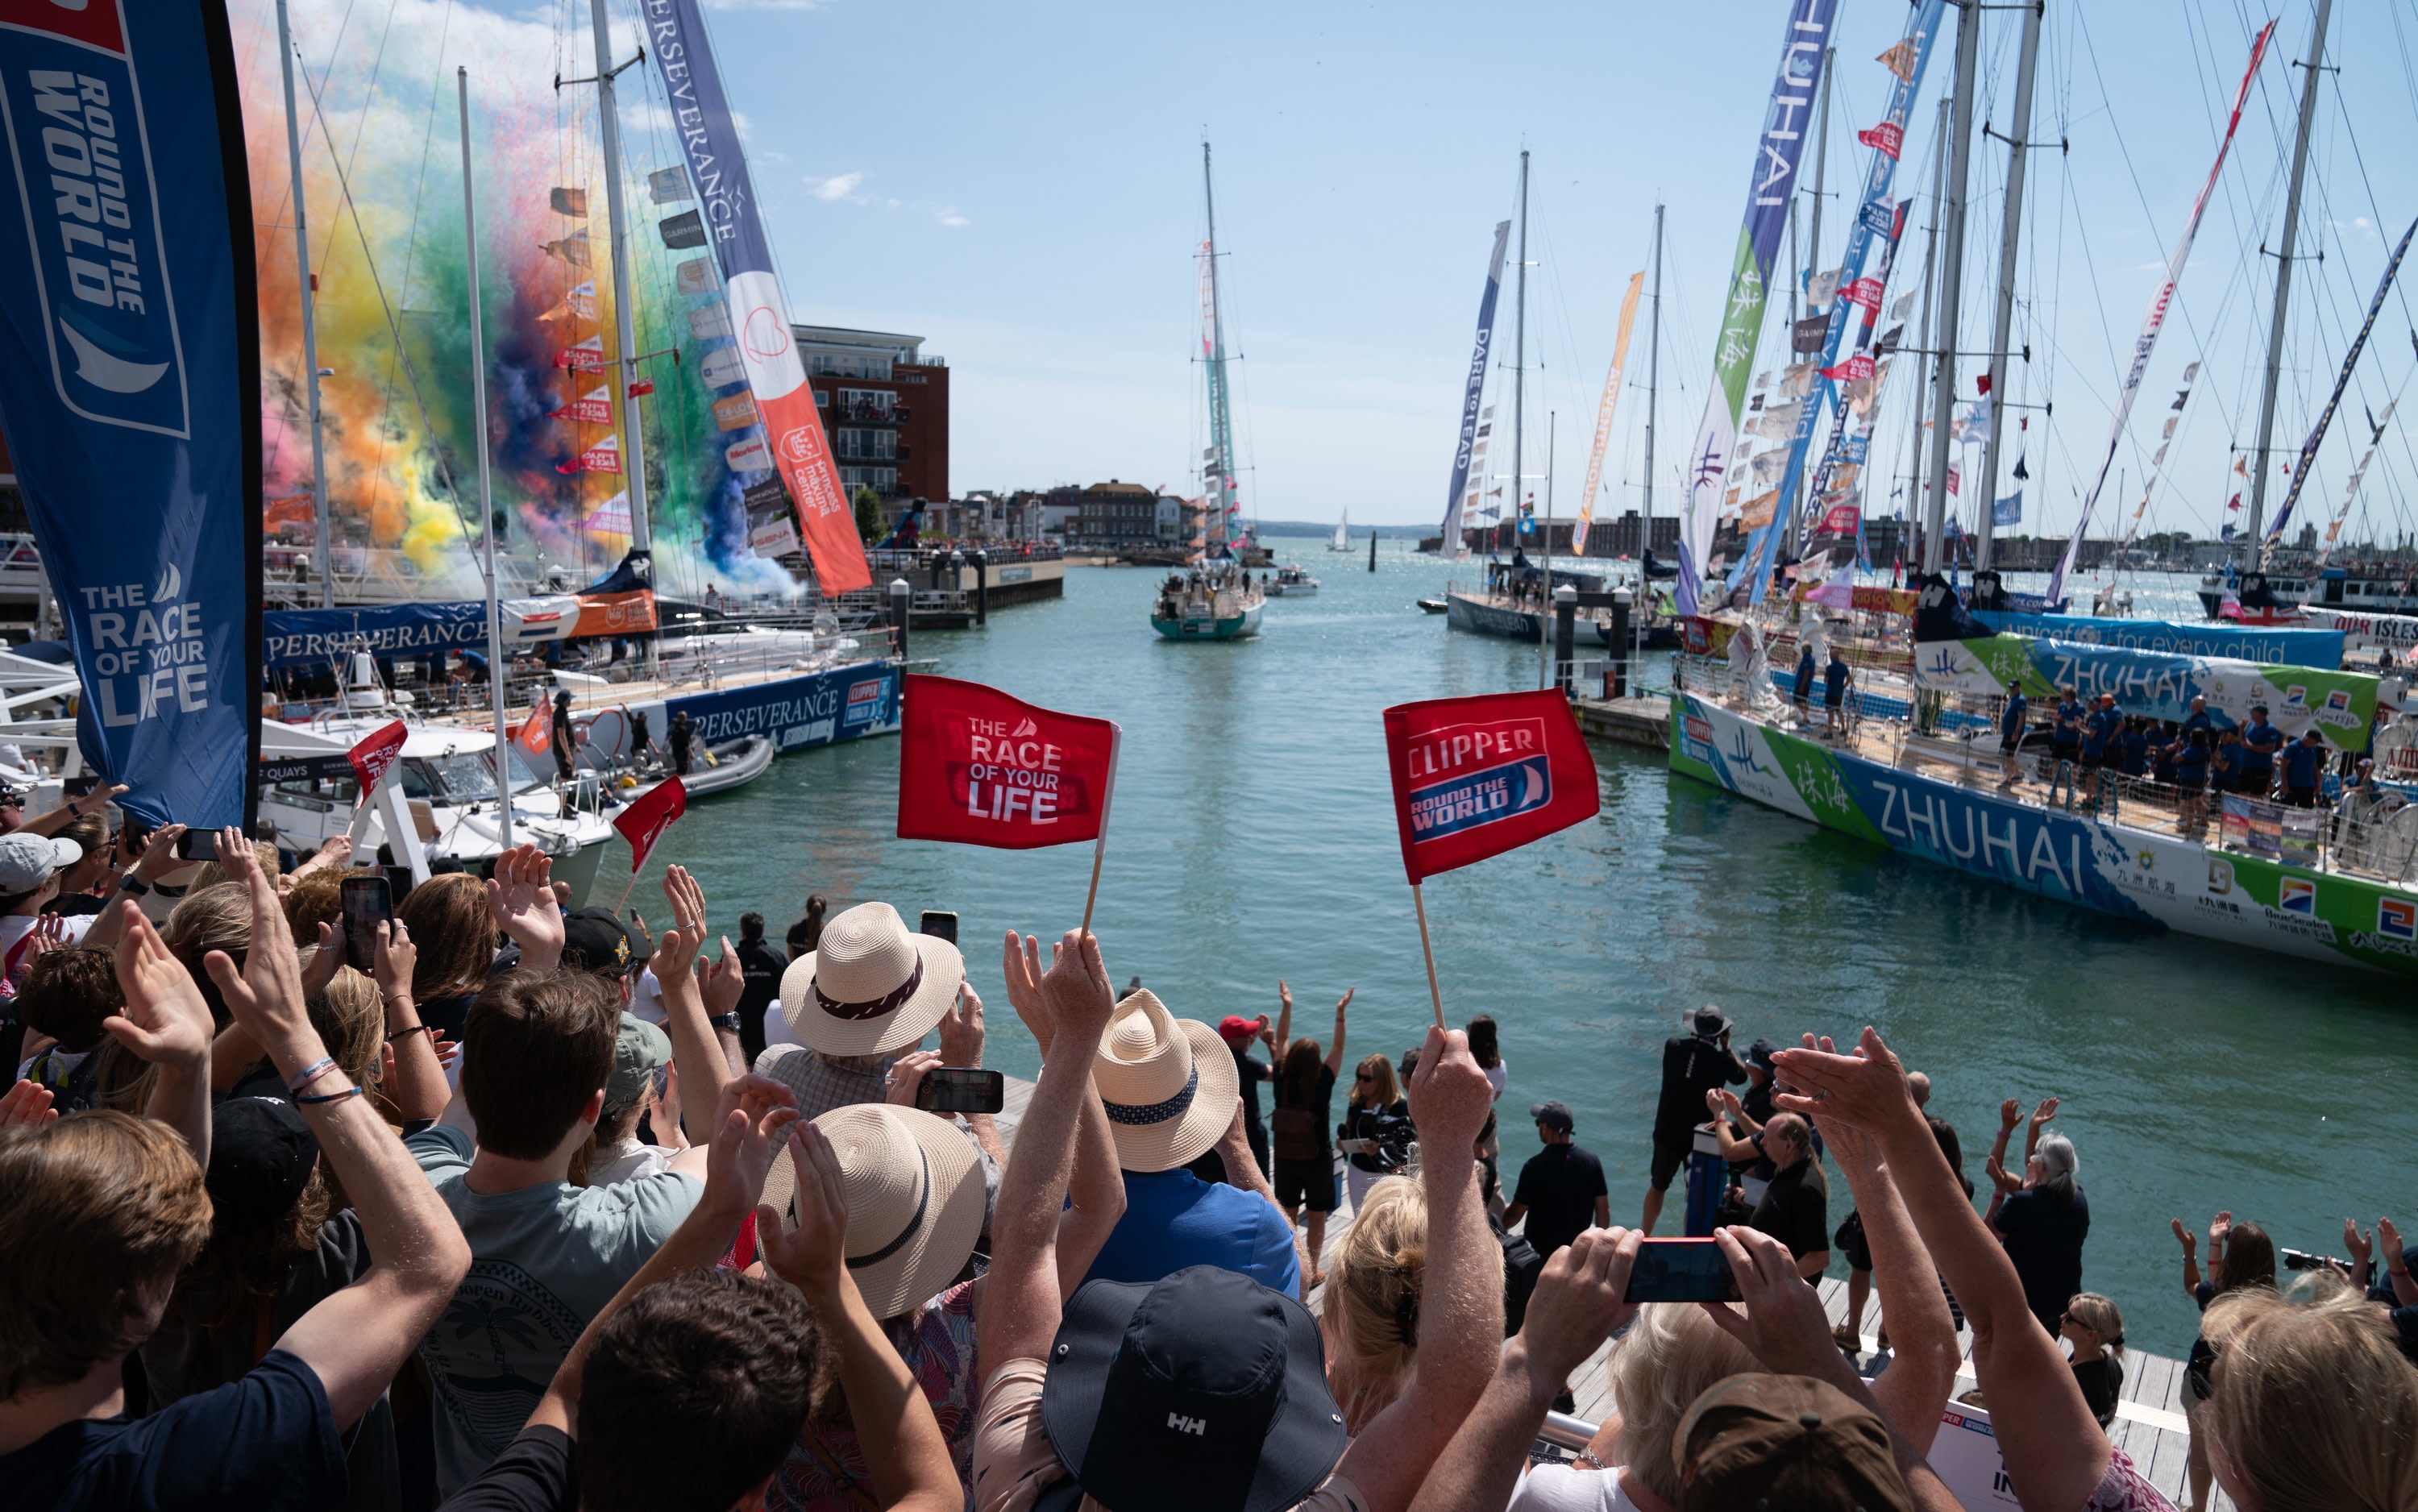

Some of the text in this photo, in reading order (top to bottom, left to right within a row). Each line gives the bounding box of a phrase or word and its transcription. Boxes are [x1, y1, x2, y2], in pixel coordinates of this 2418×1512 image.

[29, 69, 114, 307] WORLD
[77, 73, 145, 315] ROUND THE
[665, 224, 700, 239] GARMIN
[1456, 328, 1489, 470] DARE TO LEAD
[730, 443, 762, 460] Marlow
[795, 468, 816, 509] center
[815, 459, 841, 513] princess
[755, 530, 791, 547] SENA
[81, 584, 147, 609] THE
[89, 603, 202, 650] RACE
[265, 622, 489, 662] PERSEVERANCE
[95, 641, 206, 675] OF YOUR
[2151, 635, 2218, 658] every
[2225, 637, 2286, 665] child
[98, 663, 209, 727] LIFE
[850, 682, 879, 701] CLIPPER
[2053, 655, 2187, 704] ZHUHAI
[698, 688, 838, 738] PERSEVERANCE
[969, 717, 1007, 737] THE
[1688, 717, 1710, 741] CLIPPER
[323, 760, 351, 770] GUNWHA
[361, 752, 383, 790] LIFE
[970, 735, 1062, 771] RACE
[1408, 729, 1534, 779] CLIPPER
[268, 765, 308, 782] QUAYS
[970, 763, 1058, 791] OF YOUR
[968, 782, 1058, 825] LIFE
[1410, 777, 1507, 815] ROUND THE
[1412, 789, 1509, 832] WORLD
[1872, 779, 2084, 895] ZHUHAI
[1167, 1411, 1206, 1436] HH
